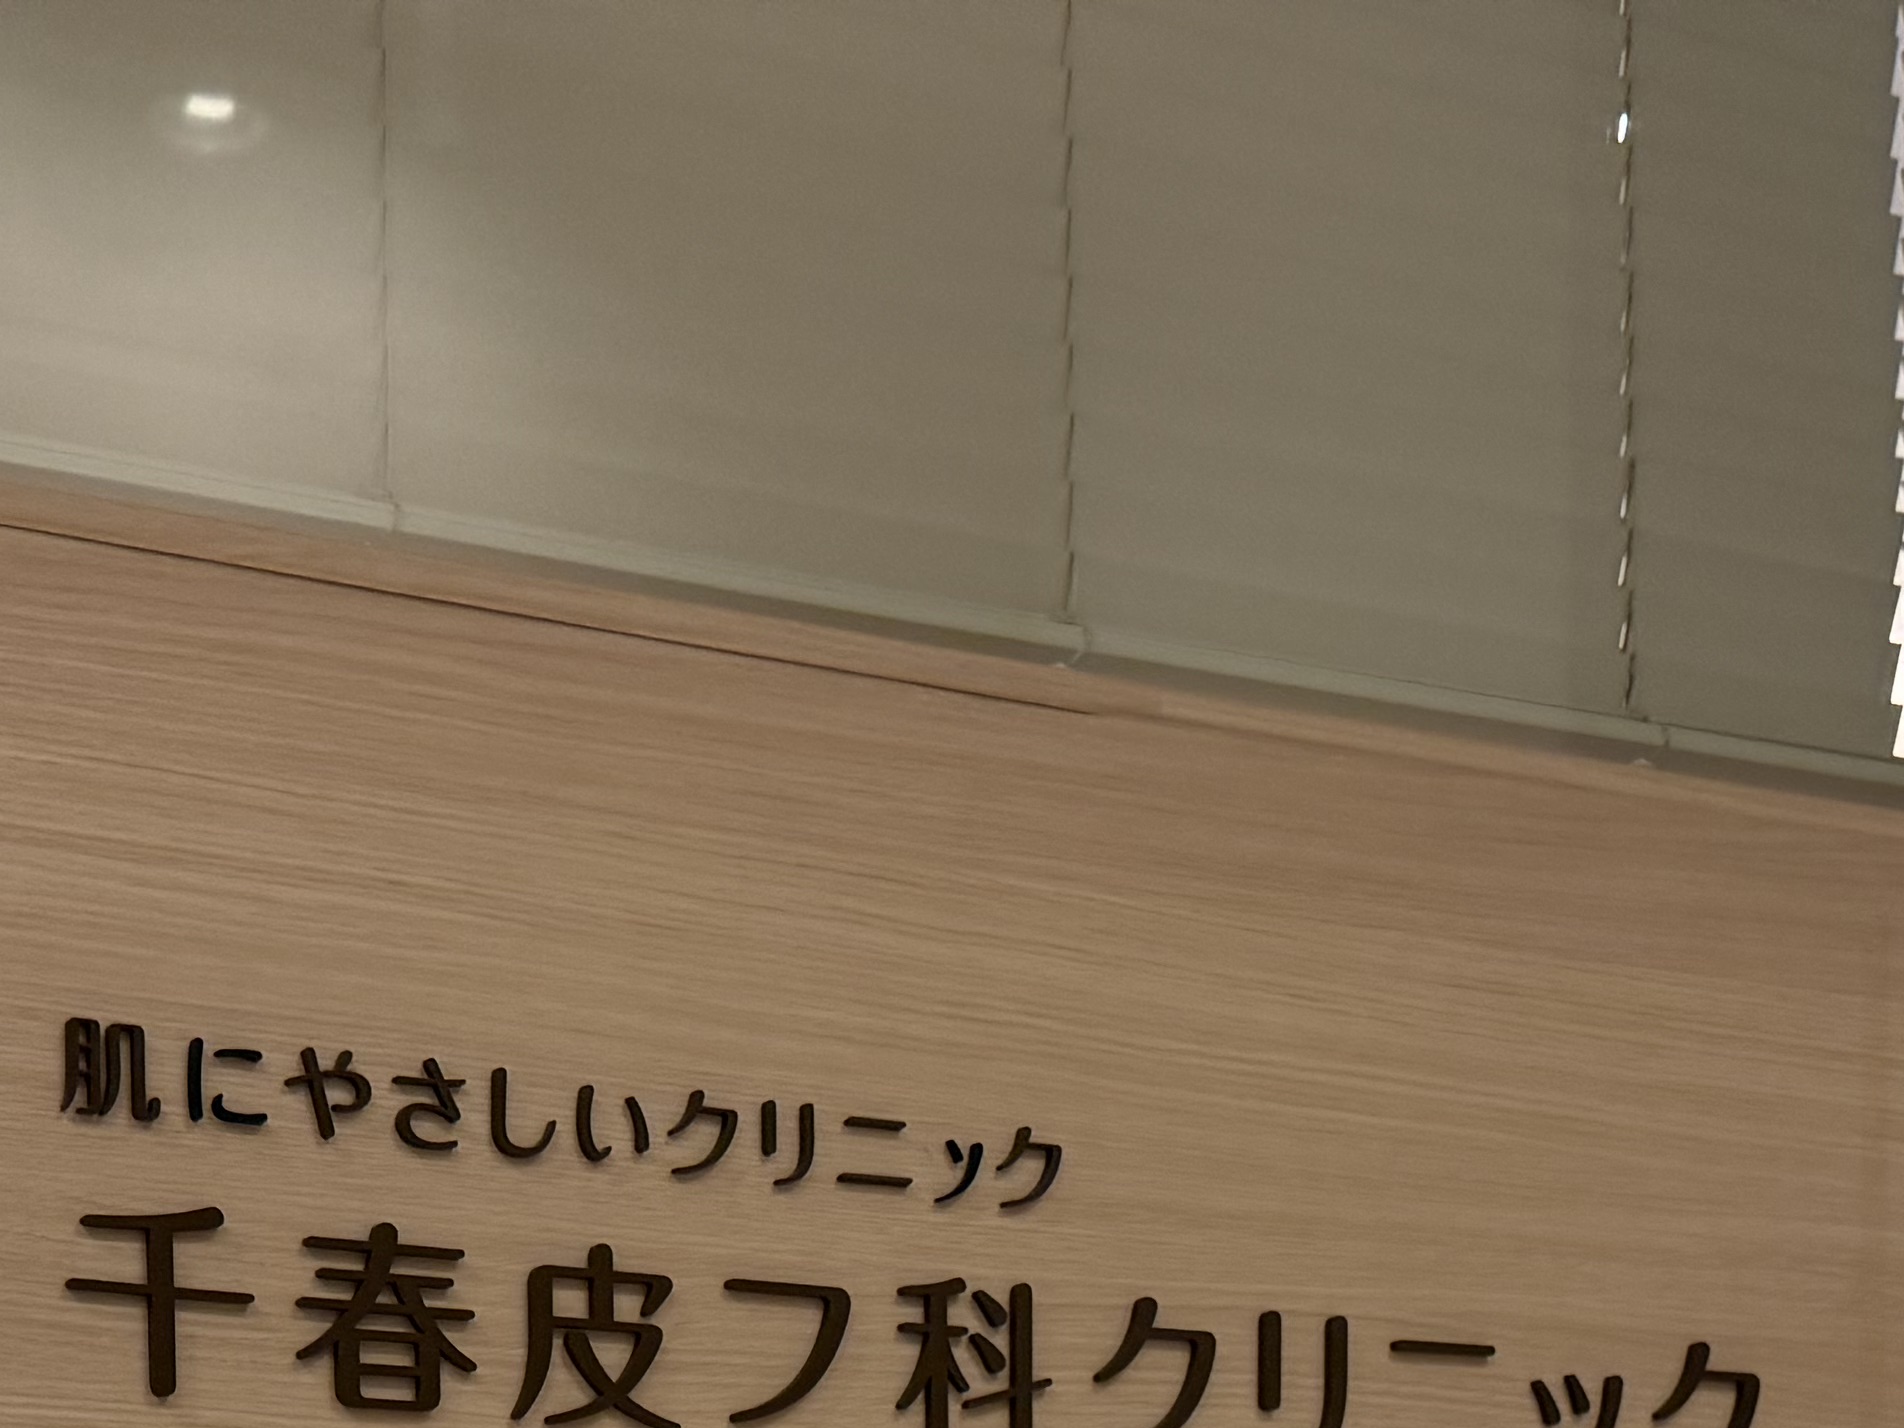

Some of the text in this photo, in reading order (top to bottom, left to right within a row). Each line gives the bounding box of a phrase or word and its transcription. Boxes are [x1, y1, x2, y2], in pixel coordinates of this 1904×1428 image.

[61, 1015, 1064, 1210] 肌にやさしいクリニック
